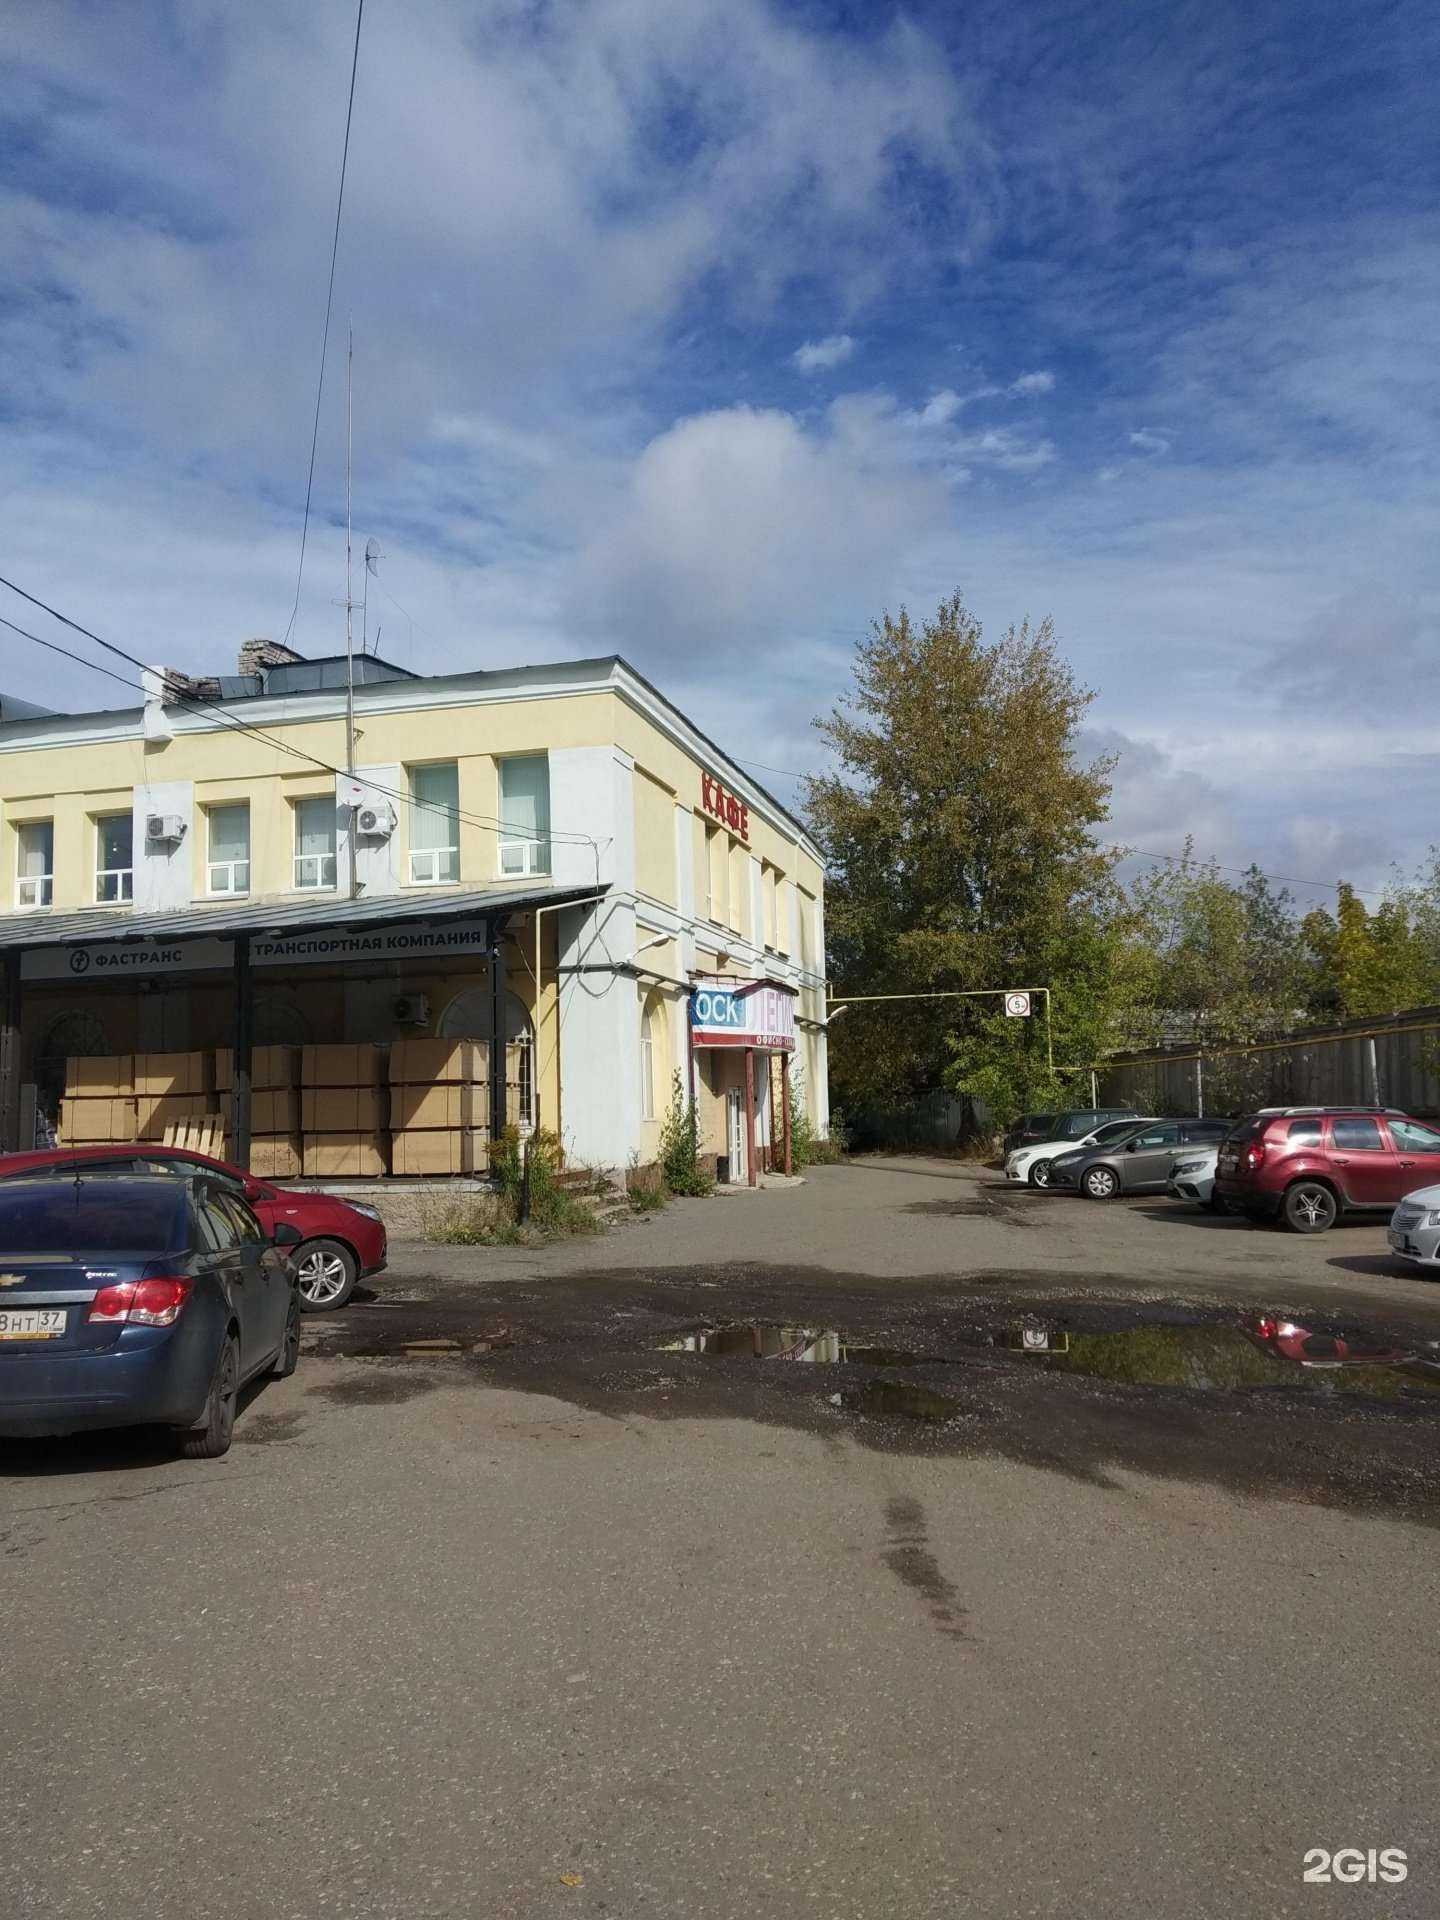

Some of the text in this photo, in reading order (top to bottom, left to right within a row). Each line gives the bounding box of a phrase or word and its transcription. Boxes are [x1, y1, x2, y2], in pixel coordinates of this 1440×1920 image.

[701, 769, 749, 841] КАФЕ
[254, 930, 481, 957] ТРАНСПОРТНАЯ КОМПАНИЯ
[95, 950, 183, 968] ФАСТРАНС
[41, 1311, 60, 1326] 37
